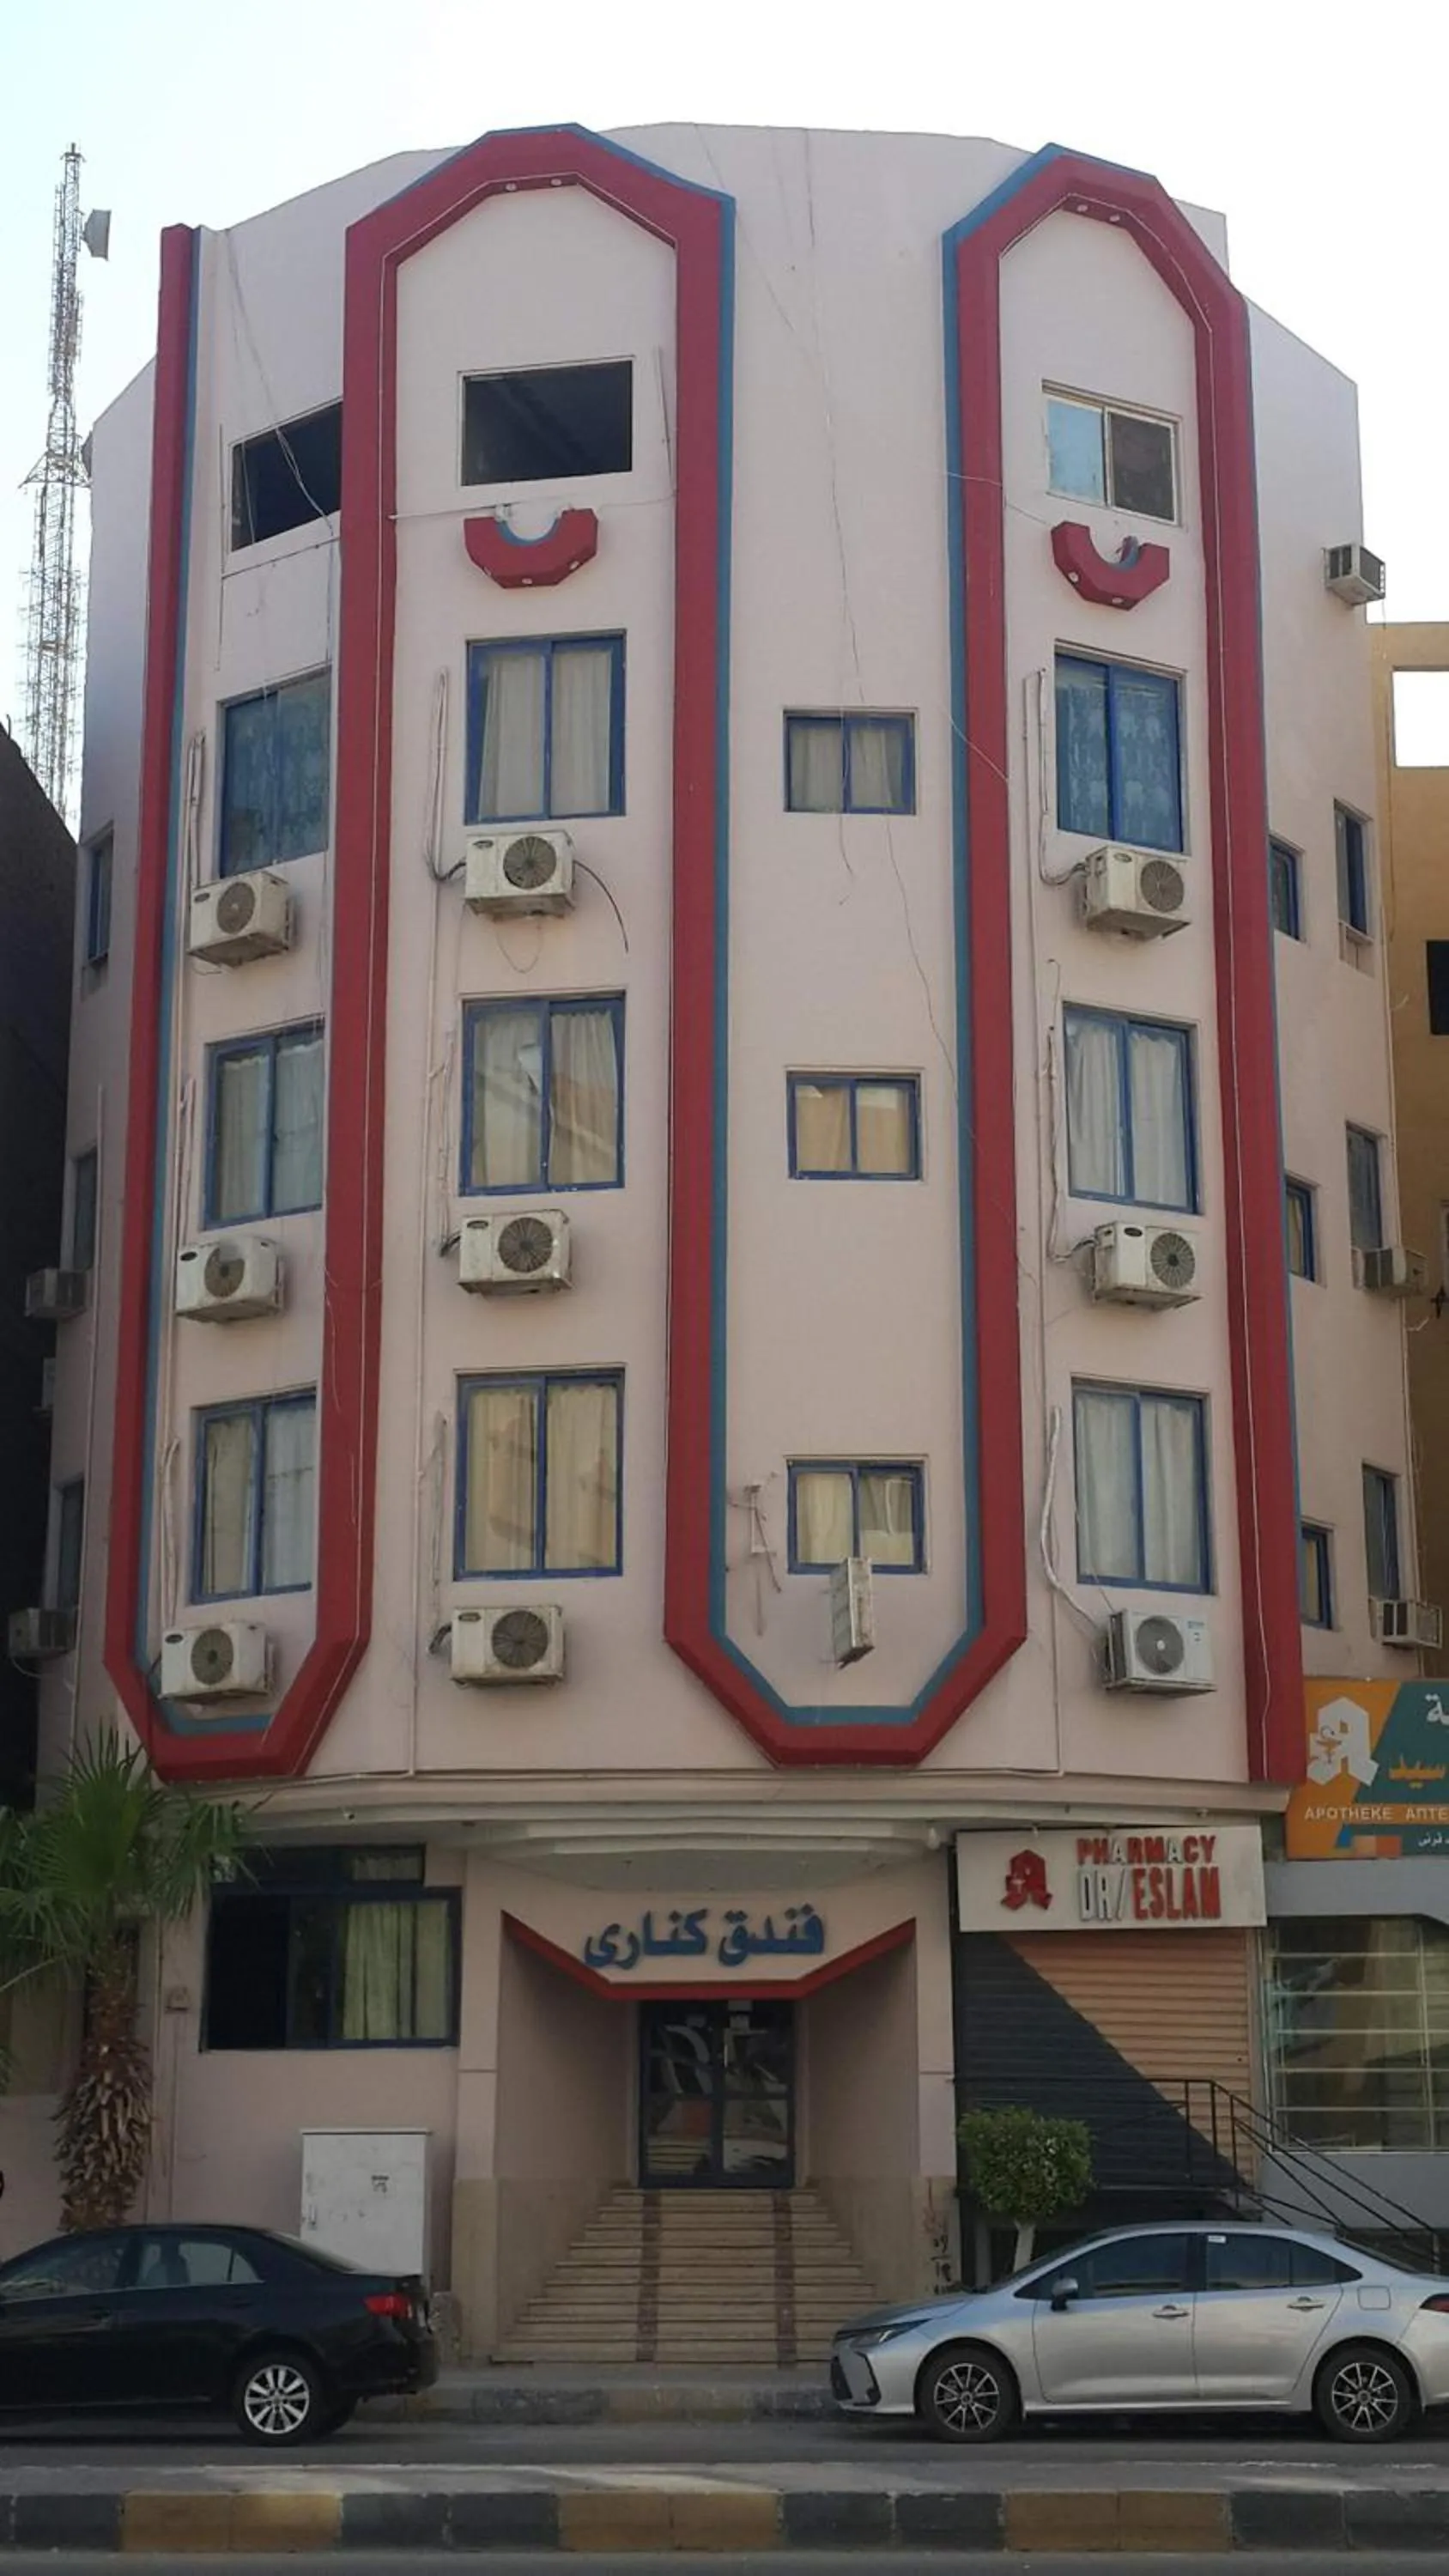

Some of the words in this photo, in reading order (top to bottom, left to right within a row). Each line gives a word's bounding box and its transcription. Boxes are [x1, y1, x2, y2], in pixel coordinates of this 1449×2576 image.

[1304, 1806, 1394, 1820] APOTHEKE
[1076, 1834, 1216, 1866] PHARMACY
[718, 1903, 825, 1967] فندق
